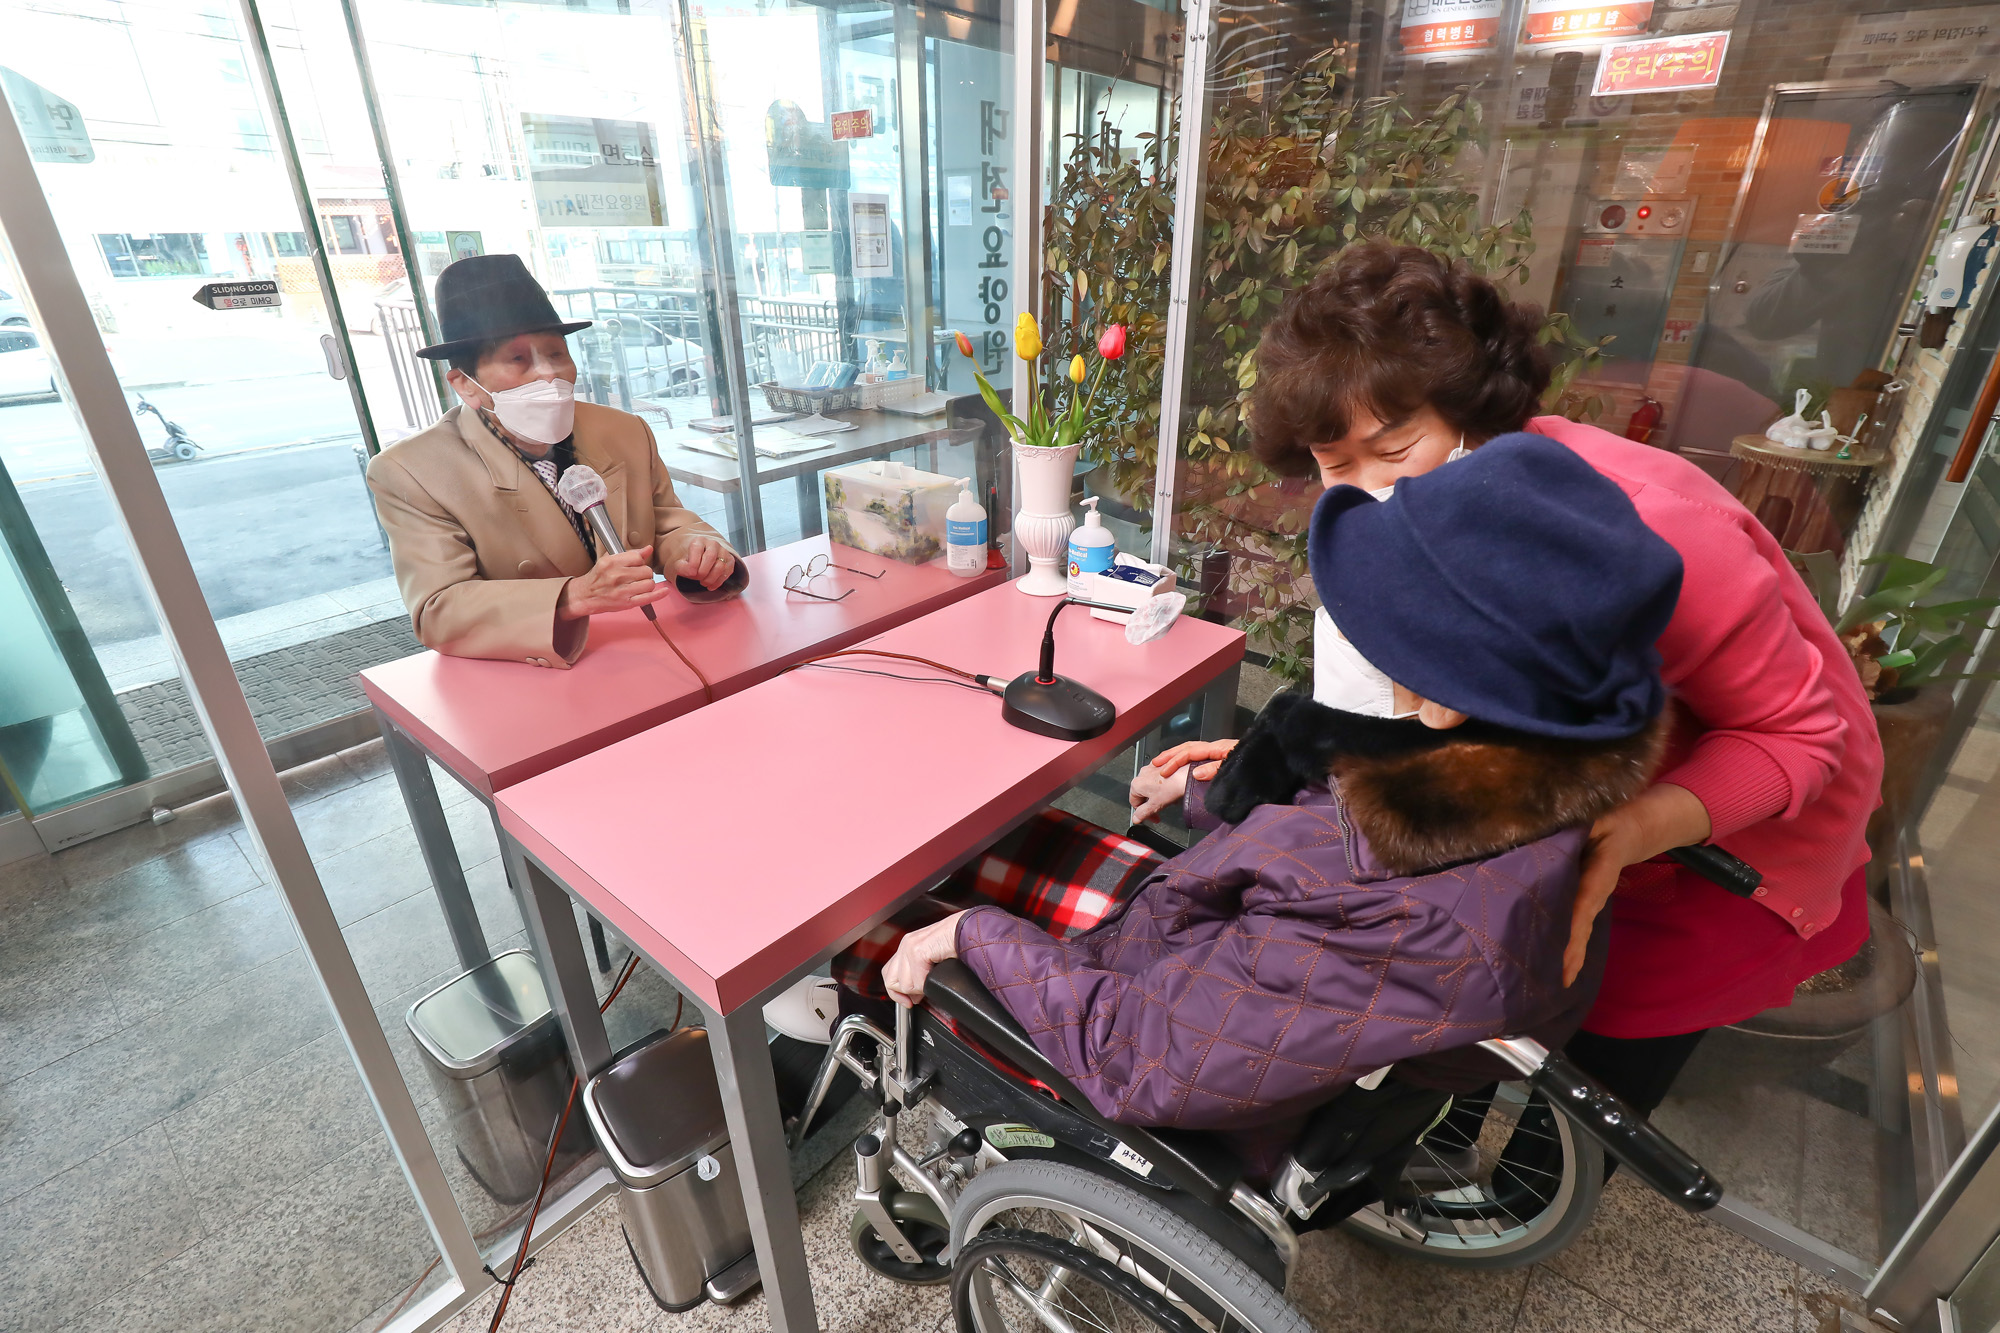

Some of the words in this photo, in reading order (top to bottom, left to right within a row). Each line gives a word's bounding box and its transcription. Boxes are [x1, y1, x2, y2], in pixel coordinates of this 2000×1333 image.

[1470, 3, 1497, 11] HOSPITAL
[1424, 25, 1475, 43] 협력병원
[1608, 47, 1716, 83] 유리주의
[834, 117, 869, 135] 유리주의
[601, 143, 658, 168] 면회실
[575, 193, 647, 211] 대전요양원
[212, 285, 246, 294] SLIDING
[248, 283, 275, 292] DOOR
[250, 296, 273, 305] 미세요
